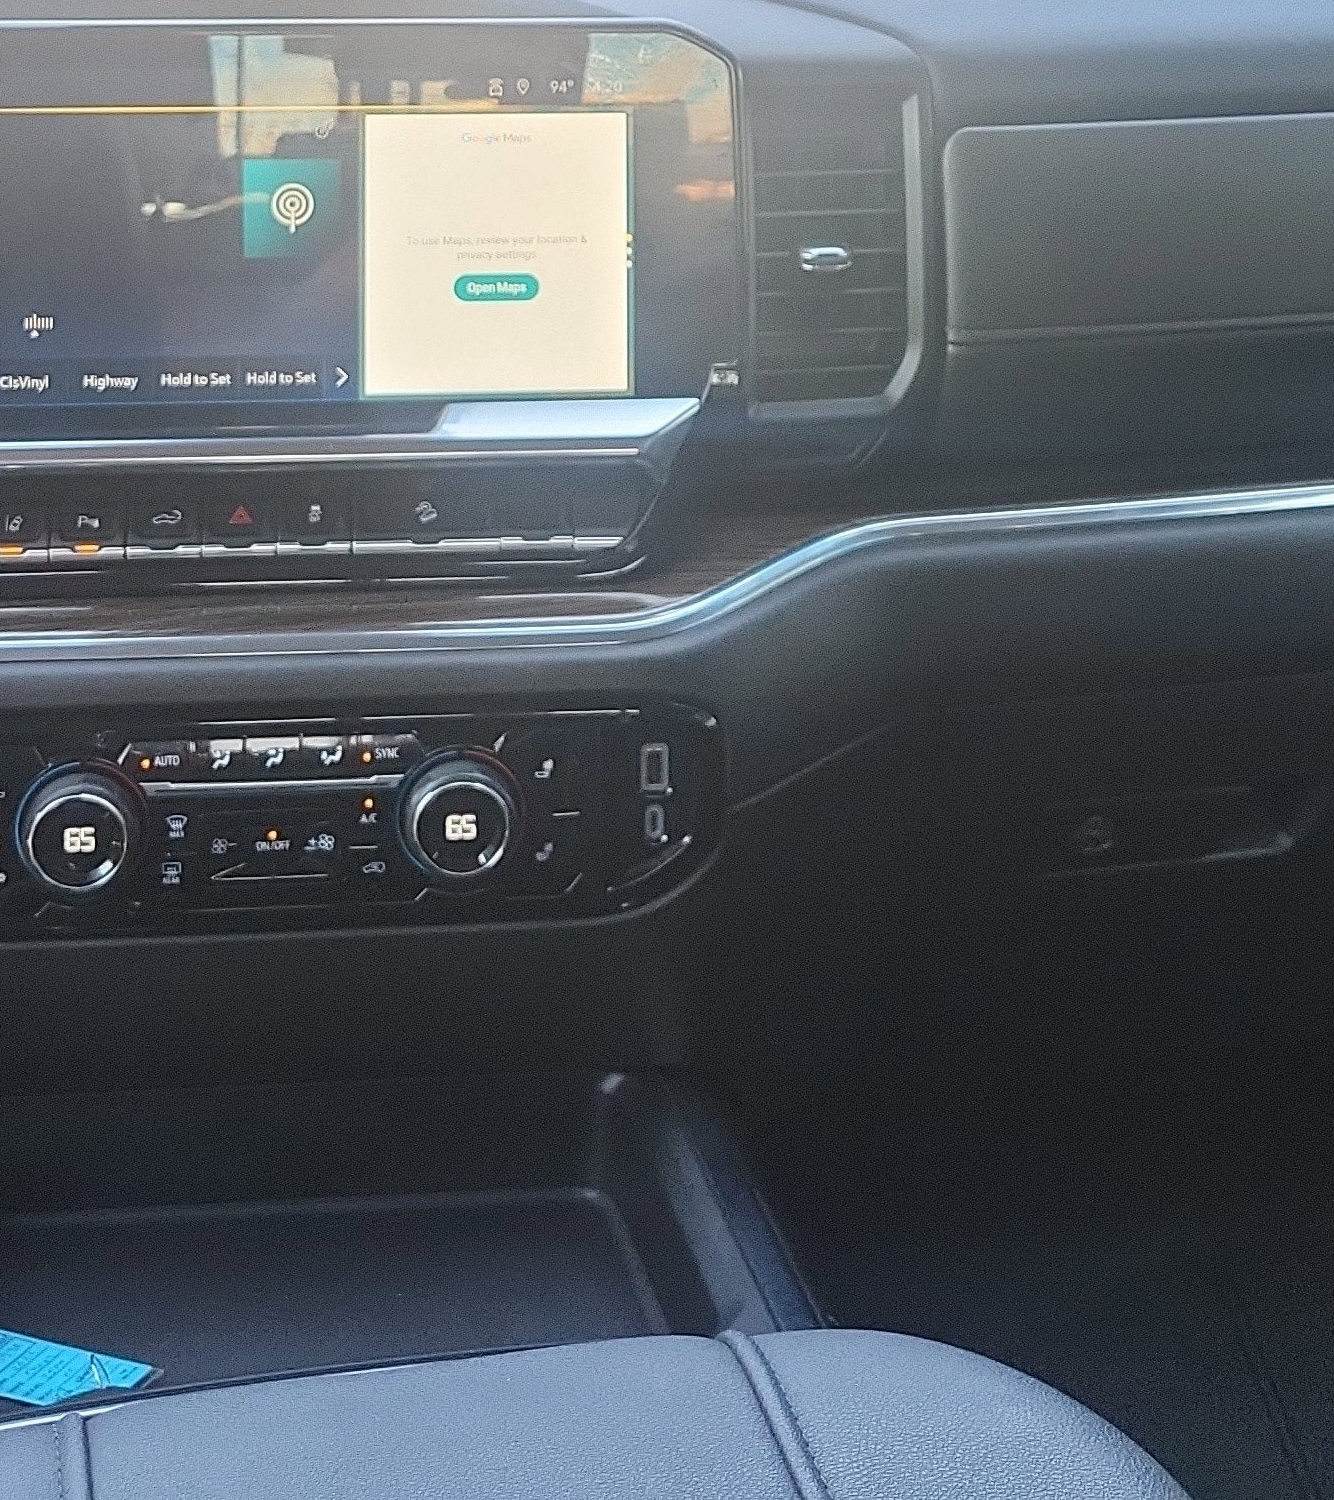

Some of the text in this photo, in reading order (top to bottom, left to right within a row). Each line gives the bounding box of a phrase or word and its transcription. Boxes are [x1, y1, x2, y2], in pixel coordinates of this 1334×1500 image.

[550, 79, 574, 94] 94°
[503, 132, 532, 144] Maps
[405, 235, 419, 245] To
[422, 236, 440, 245] use
[476, 234, 510, 245] review
[512, 235, 534, 247] your
[537, 233, 578, 244] location
[456, 250, 493, 261] privacy
[466, 281, 527, 296] Open Maps
[83, 373, 138, 393] Highway
[161, 372, 232, 387] Hold to Set
[246, 370, 318, 386] Hold to Set
[154, 754, 180, 767] AUTO
[375, 748, 400, 760] SYNC
[359, 813, 377, 824] A/C
[445, 814, 477, 841] 65
[63, 826, 96, 854] 65
[256, 839, 291, 851] ON/OFF
